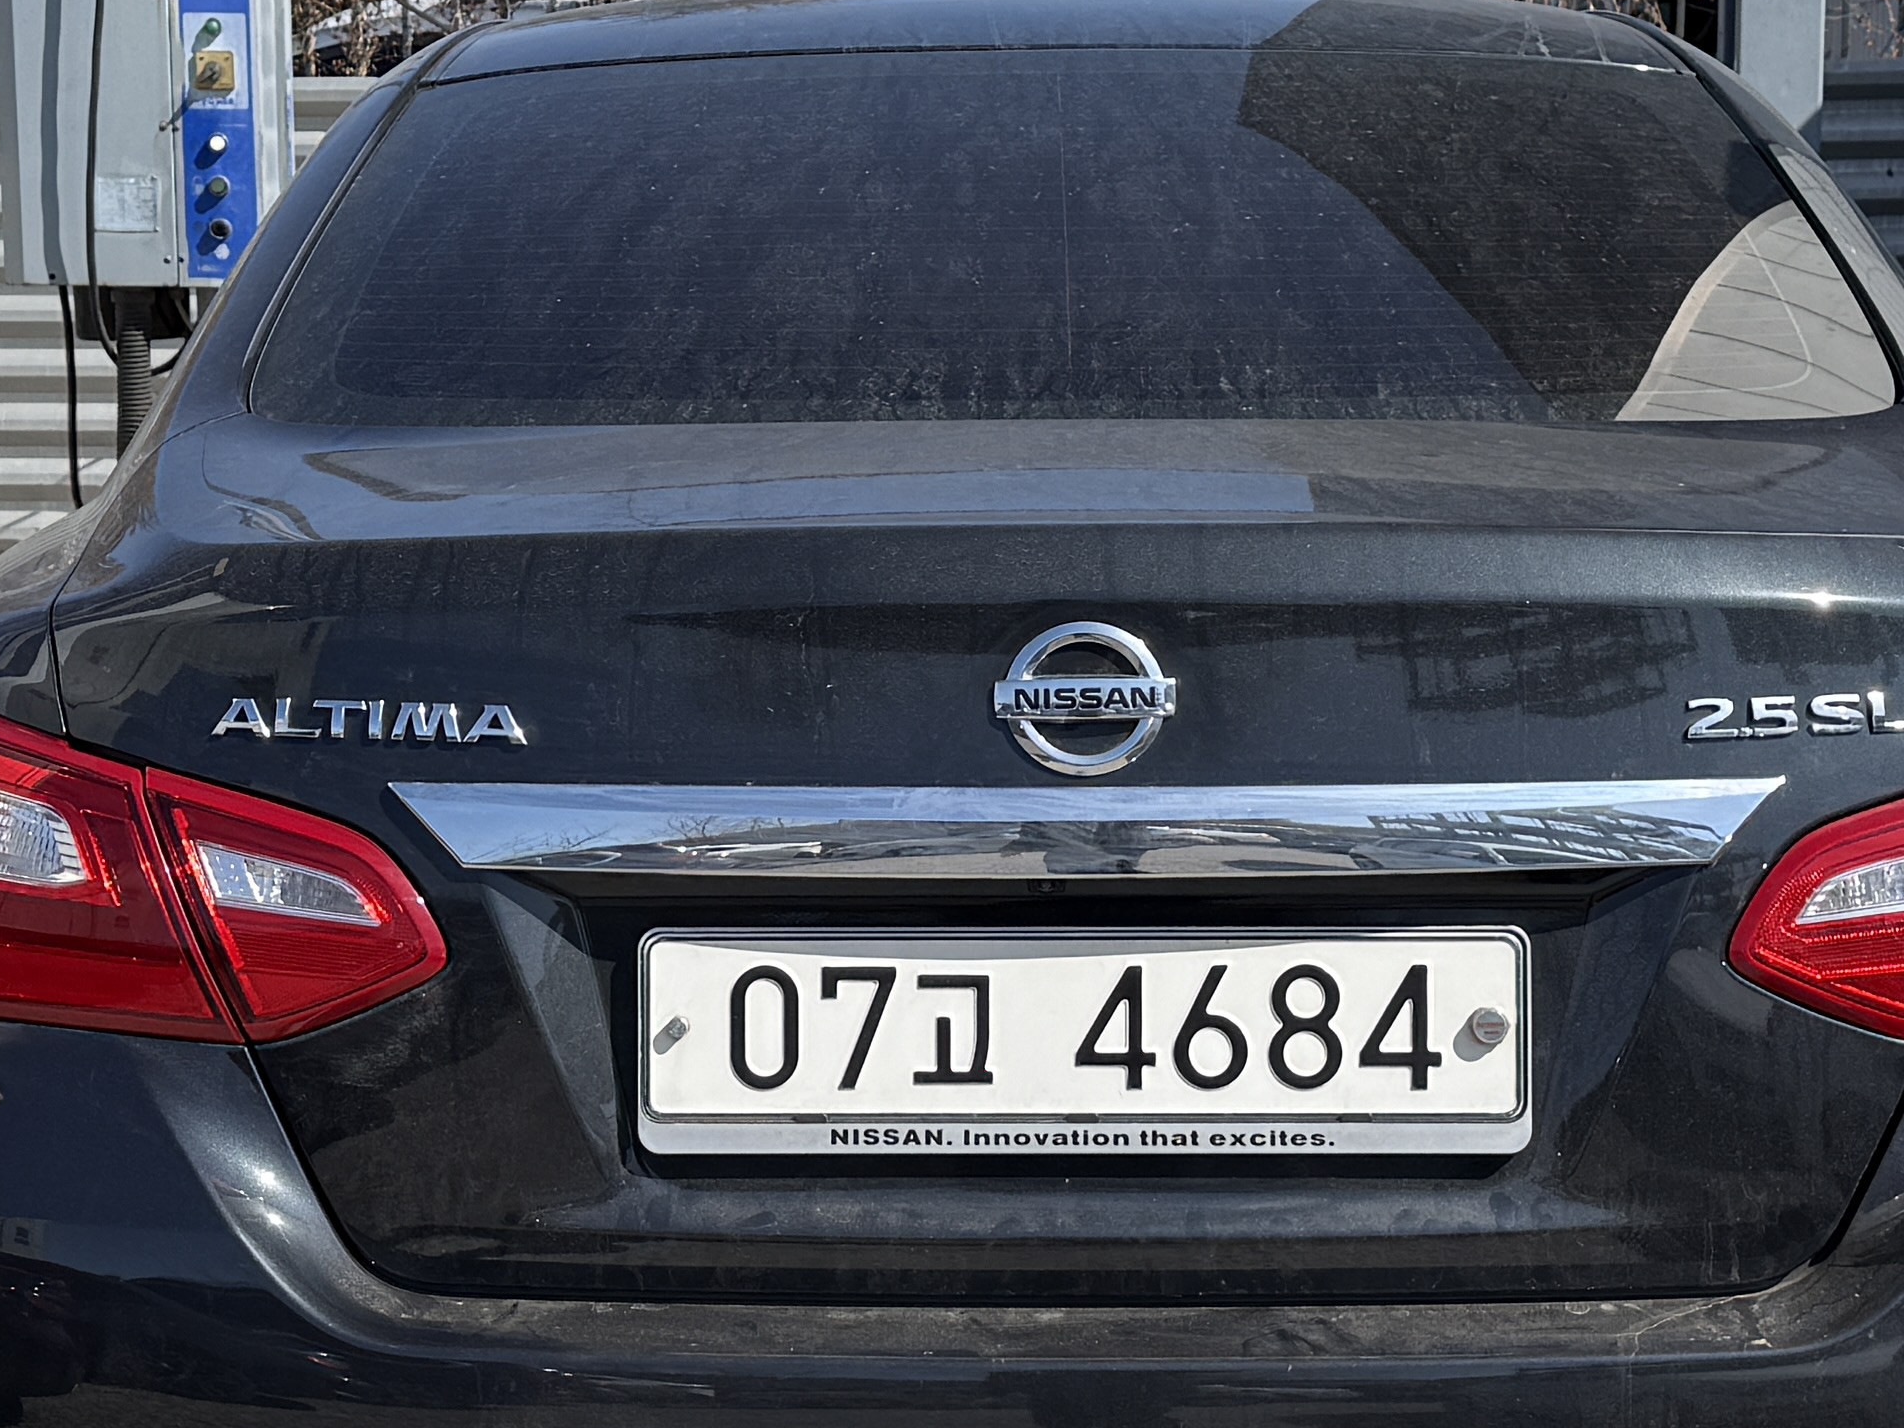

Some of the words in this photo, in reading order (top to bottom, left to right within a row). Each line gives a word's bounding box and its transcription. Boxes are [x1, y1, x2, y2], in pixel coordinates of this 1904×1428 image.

[1014, 686, 1158, 711] NISSAN
[210, 698, 528, 746] ALTIMA
[730, 965, 995, 1090] 07고
[1075, 964, 1442, 1090] 4684
[830, 1128, 953, 1147] NISSAN.
[963, 1129, 1130, 1147] Innovation
[1139, 1130, 1199, 1147] that
[1209, 1130, 1335, 1148] excites.
